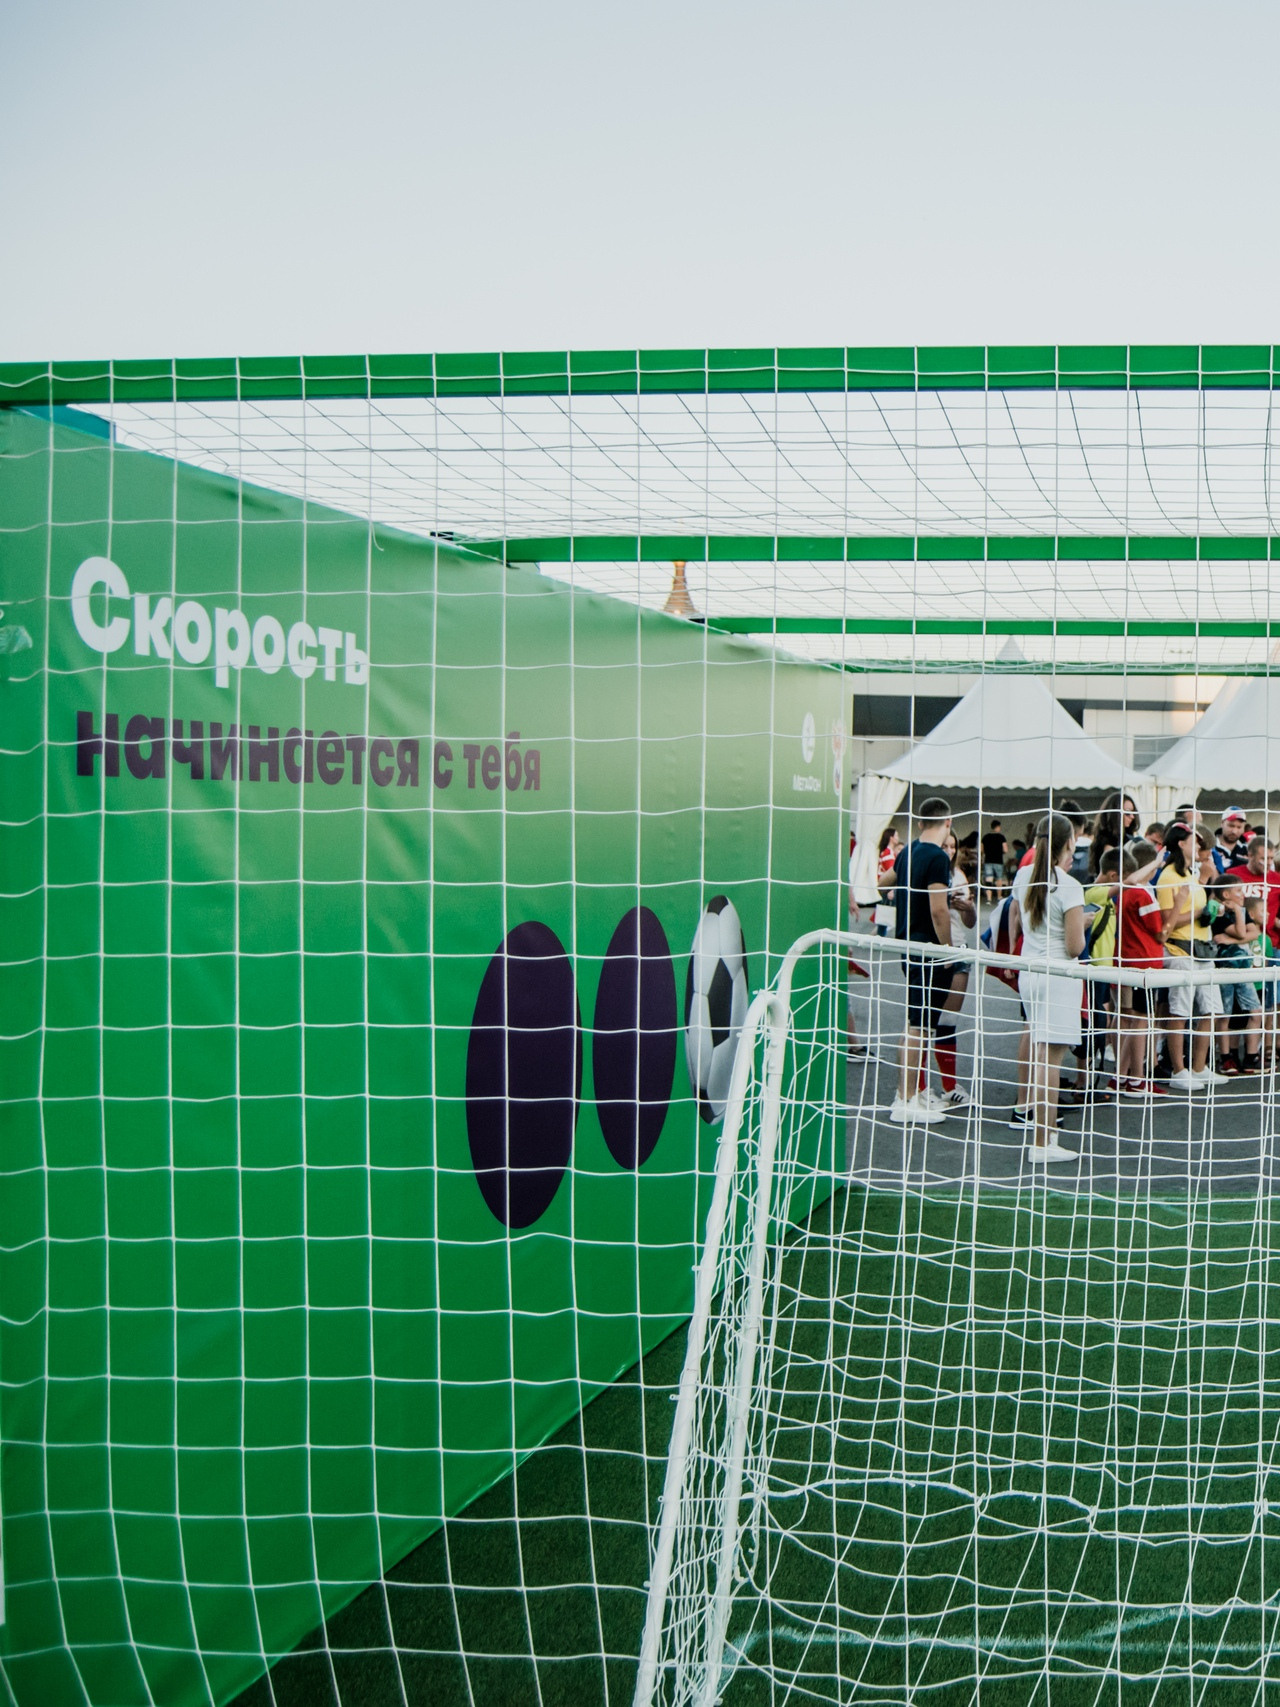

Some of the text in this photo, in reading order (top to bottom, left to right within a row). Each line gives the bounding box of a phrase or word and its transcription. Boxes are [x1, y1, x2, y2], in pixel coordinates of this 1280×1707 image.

[71, 556, 370, 688] Скорость
[76, 711, 541, 791] начинается с тебя
